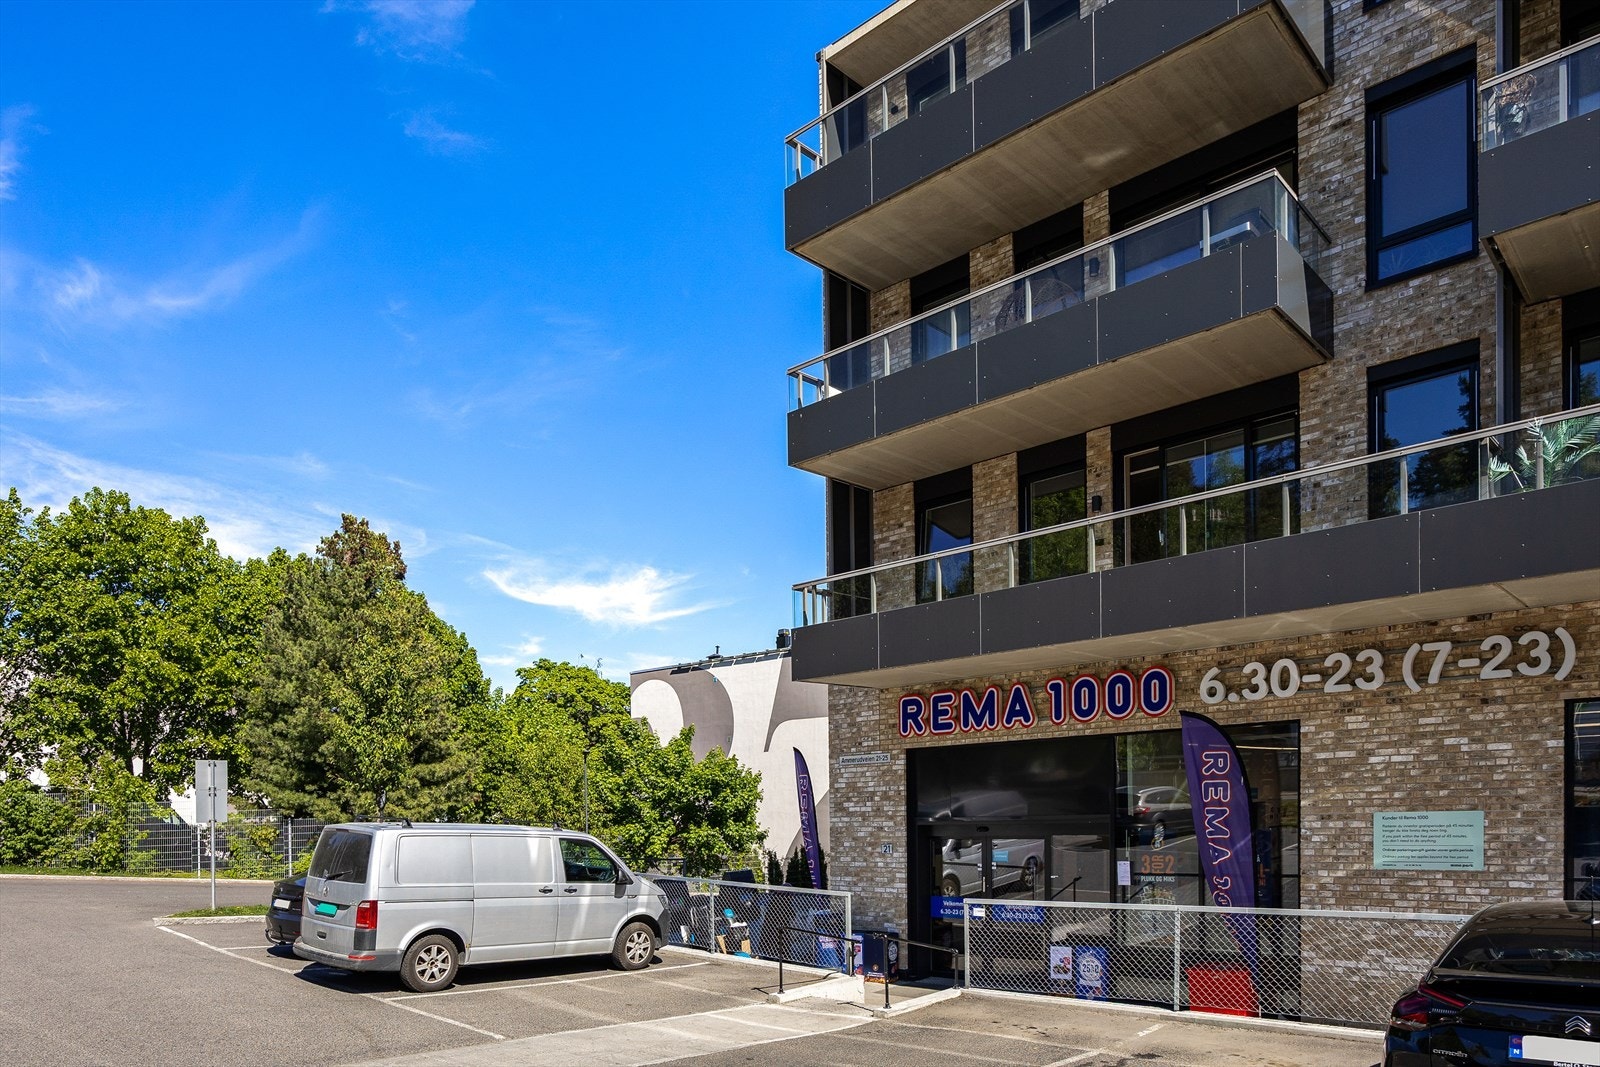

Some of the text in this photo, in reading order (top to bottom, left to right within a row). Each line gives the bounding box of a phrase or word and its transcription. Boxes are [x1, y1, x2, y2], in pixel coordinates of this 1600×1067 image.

[1200, 627, 1577, 704] 6.30-23 (7-23)
[900, 666, 1173, 737] REMA 1000
[841, 754, 889, 764] Ammerudveien 21-25
[1201, 751, 1231, 865] REMA
[1141, 854, 1150, 874] 3
[1165, 854, 1175, 874] 2
